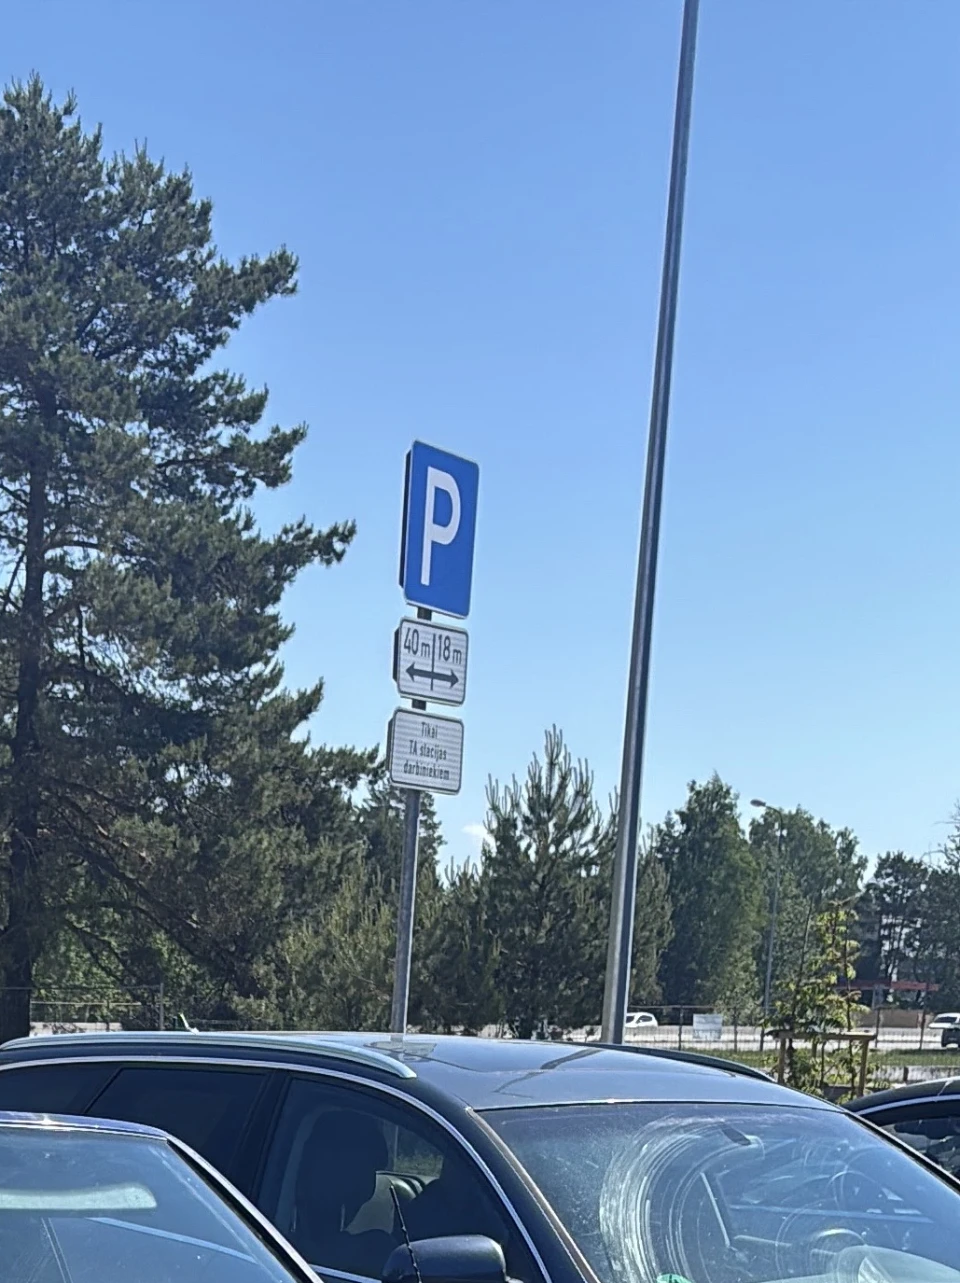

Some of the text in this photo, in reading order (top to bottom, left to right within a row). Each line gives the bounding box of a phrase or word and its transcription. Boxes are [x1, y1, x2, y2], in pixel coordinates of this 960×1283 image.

[420, 466, 461, 586] P
[403, 627, 430, 658] 40 m
[438, 634, 462, 665] 18 m
